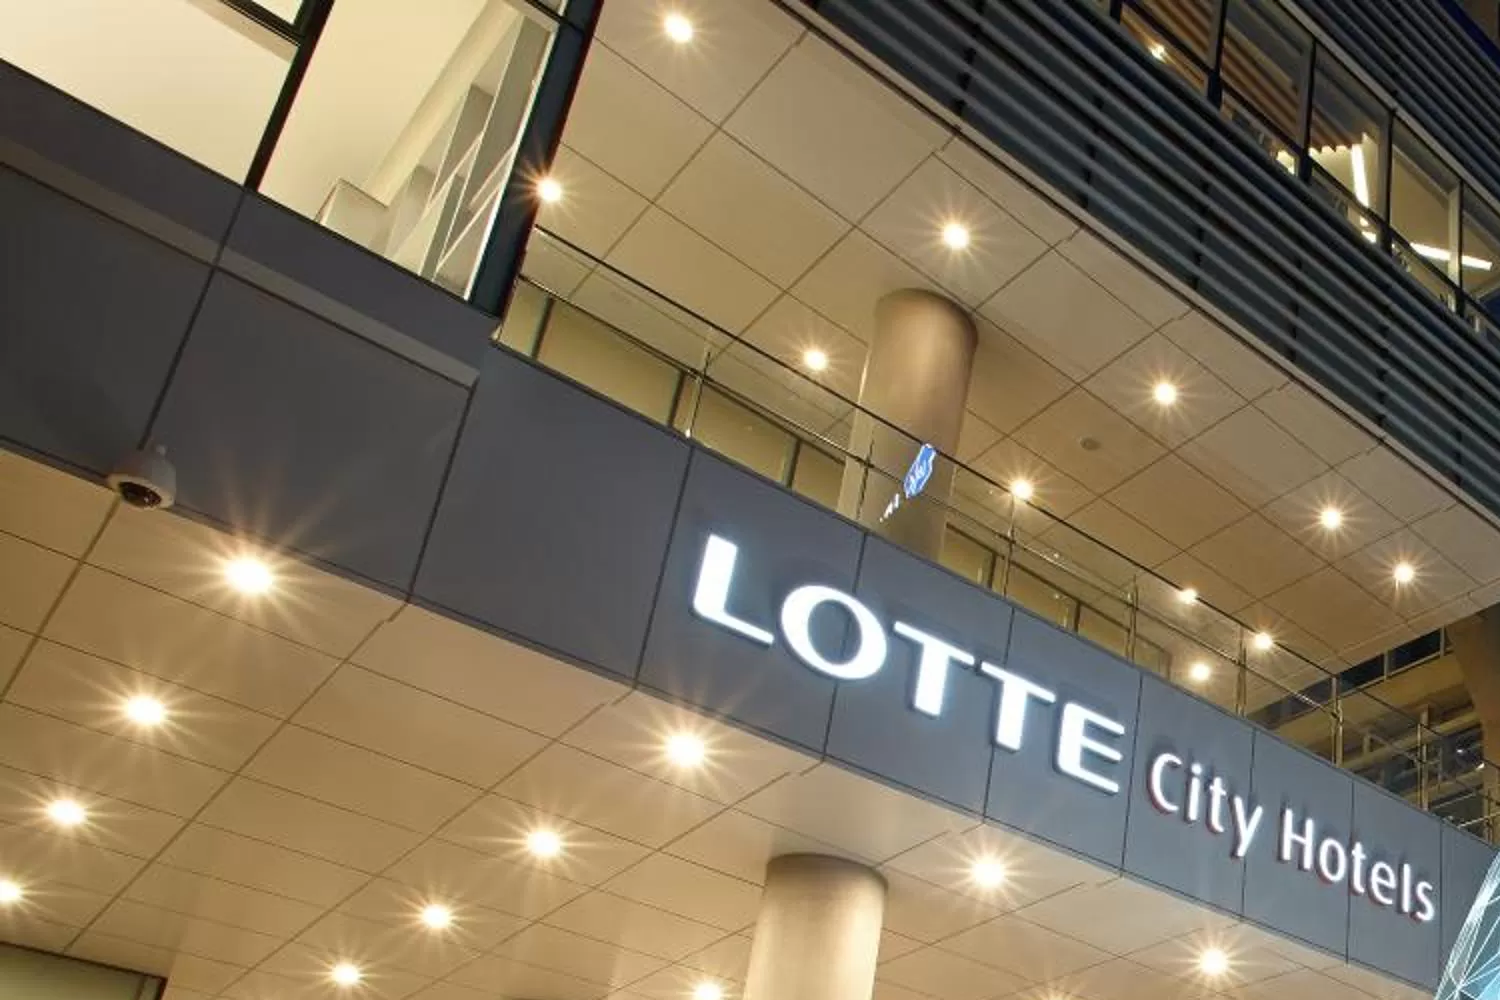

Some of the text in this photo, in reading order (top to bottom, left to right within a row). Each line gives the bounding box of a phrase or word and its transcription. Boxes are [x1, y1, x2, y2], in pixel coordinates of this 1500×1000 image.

[692, 533, 1436, 923] LOTTE City Hotels
